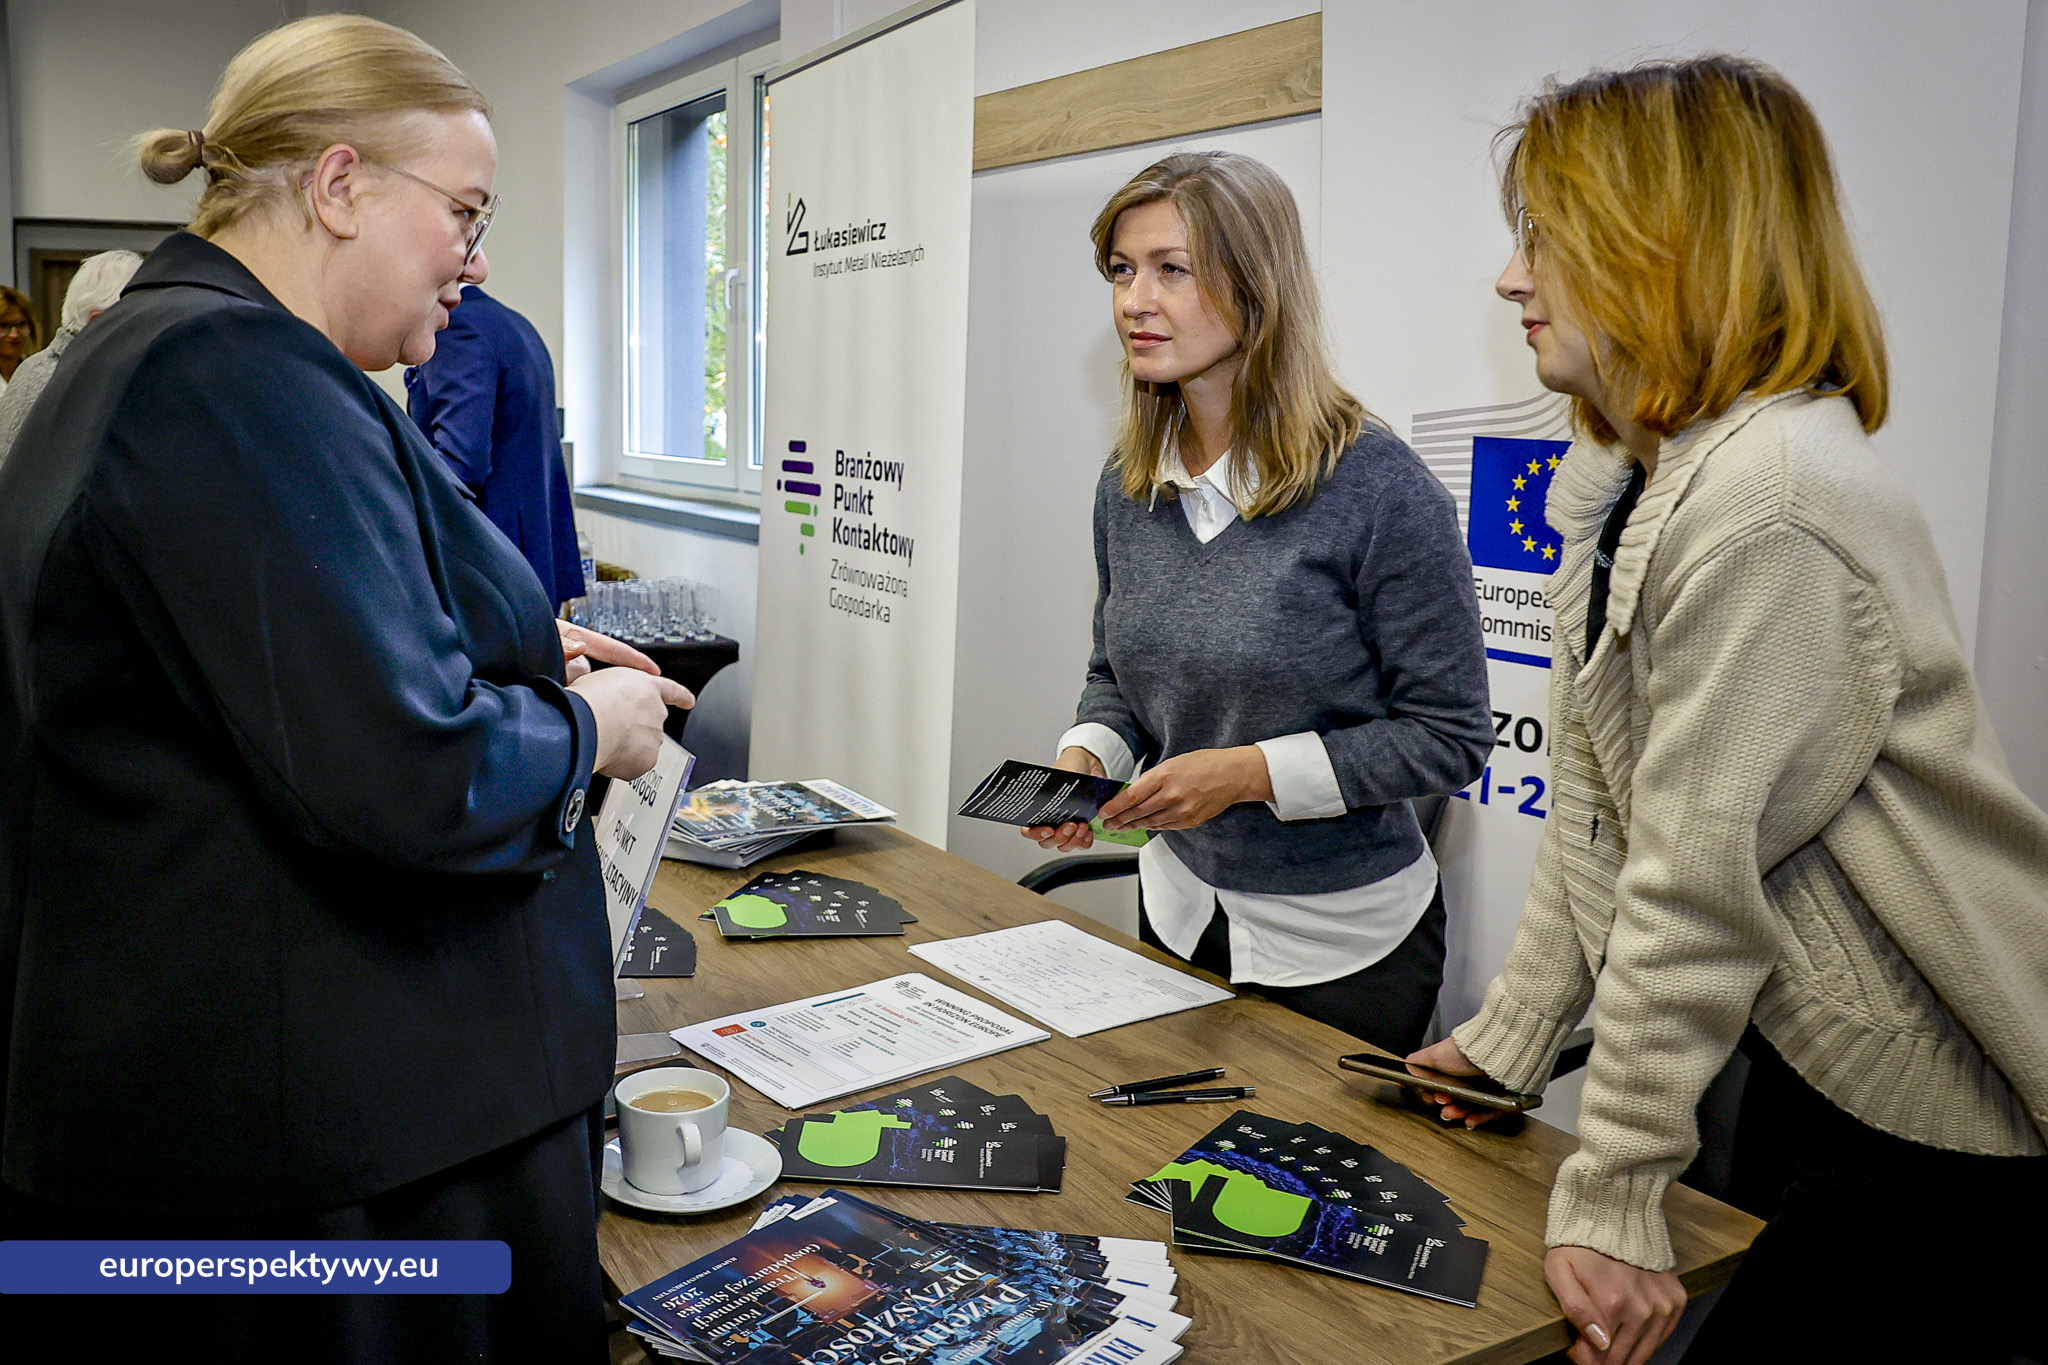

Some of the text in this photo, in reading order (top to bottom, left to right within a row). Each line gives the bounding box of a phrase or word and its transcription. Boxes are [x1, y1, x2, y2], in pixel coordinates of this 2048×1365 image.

[814, 219, 886, 252] Łukasiewicz
[813, 243, 925, 279] Instytut Metali Nieżelaznych
[835, 449, 904, 492] Branżowy
[833, 483, 874, 516] Punkt
[832, 516, 915, 568] Kontaktowy
[830, 558, 908, 598] Zrównoważona
[829, 587, 891, 624] Gospodarka
[1480, 612, 1555, 642] ommis
[628, 776, 658, 808] uropa
[612, 819, 637, 855] PUNKT
[934, 1005, 971, 1024] HORIZON
[968, 1021, 1005, 1038] EUROPE
[935, 998, 972, 1016] WINNING
[970, 1013, 1014, 1035] PROPOSAL
[724, 1243, 821, 1294] Gospodarczej
[662, 1287, 704, 1311] 2026
[676, 1290, 730, 1318] Śląska
[691, 1274, 798, 1330] Transformacji
[706, 1309, 763, 1338] Forum
